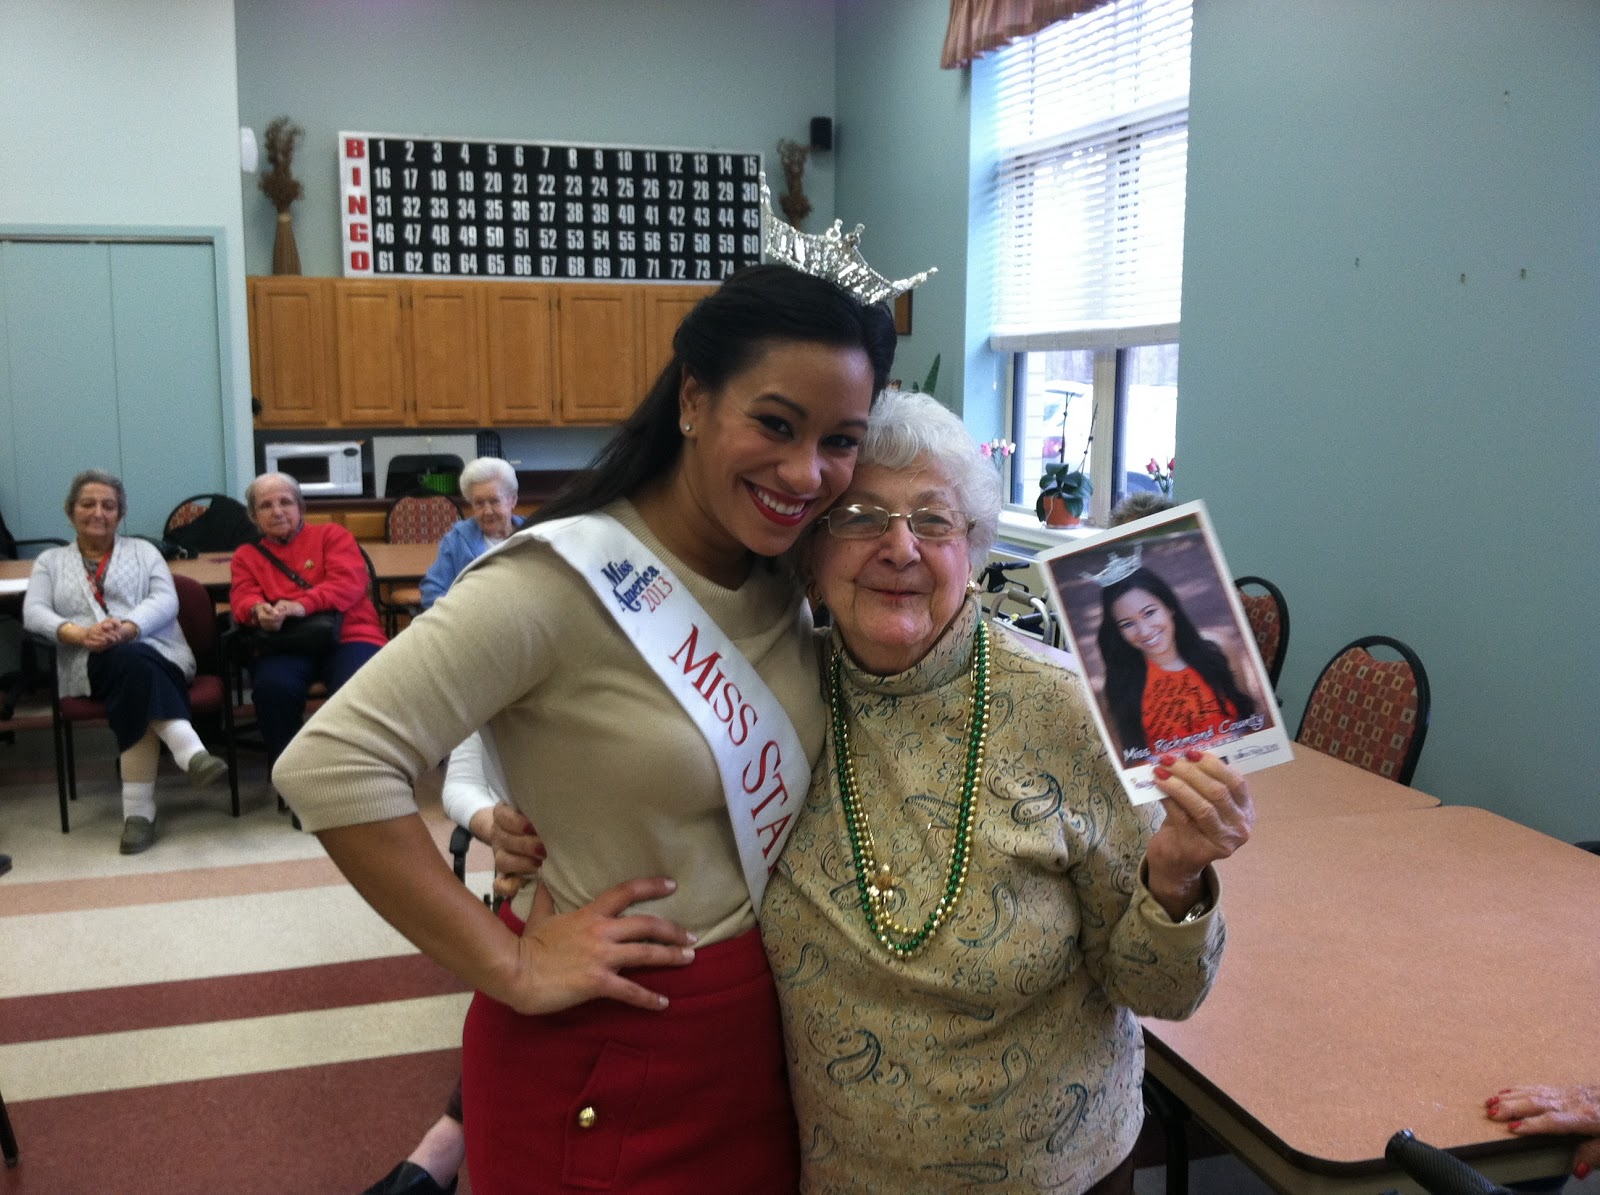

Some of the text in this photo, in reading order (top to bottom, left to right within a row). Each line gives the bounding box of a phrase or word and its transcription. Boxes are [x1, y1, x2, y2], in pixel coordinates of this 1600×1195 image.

[379, 141, 757, 176] 1 2 3 4 5 6 7 8 9 10 11 12 13 14 15
[375, 168, 758, 202] 16 17 18 19 20 21 22 23 24 25 26 27 28 29 30
[376, 196, 759, 228] 31 32 33 34 35 36 37 38 39 40 41 42 43 44 45
[376, 223, 759, 254] 46 47 48 49 50 51 52 53 54 55 56 57 58 59 60
[378, 251, 734, 279] 61 62 63 64 65 66 67 68 69 70 71 72 73 74
[601, 560, 633, 587] Miss
[613, 566, 660, 612] America
[642, 576, 673, 612] 2013
[669, 623, 793, 875] MISS STA
[1123, 746, 1151, 762] Miss
[1219, 713, 1265, 734] County
